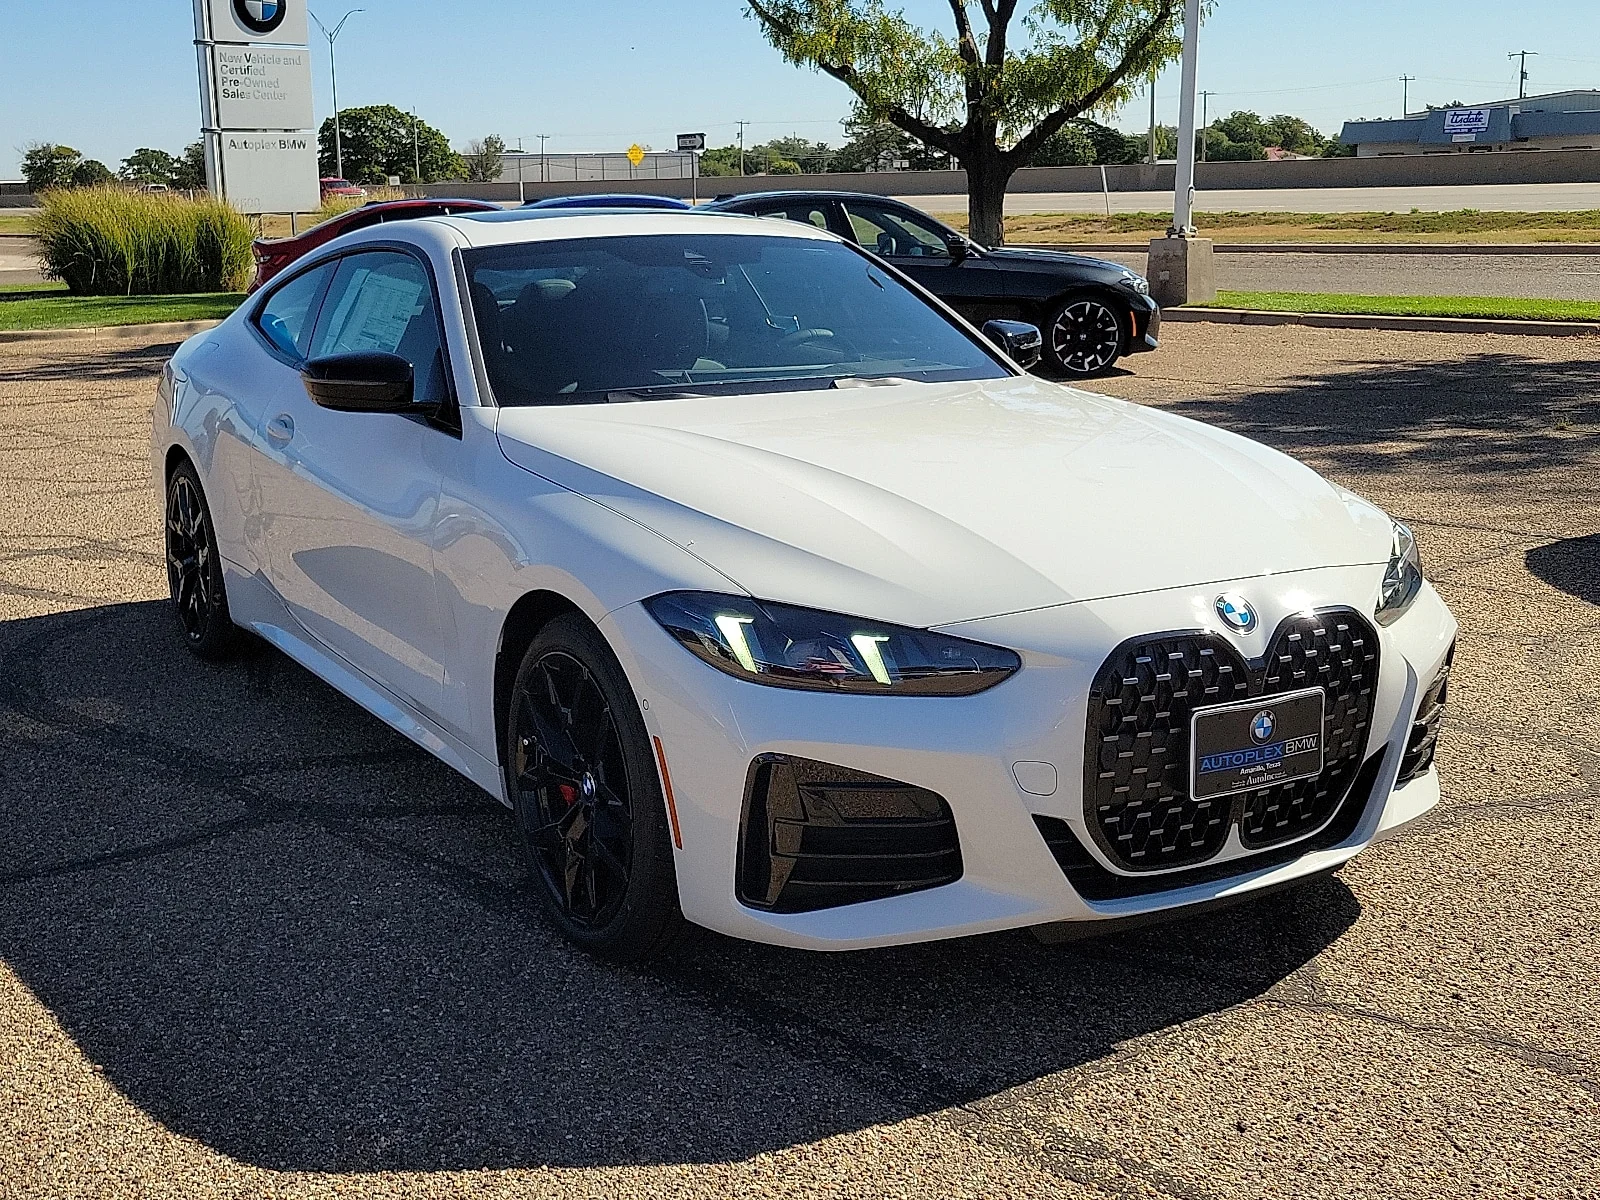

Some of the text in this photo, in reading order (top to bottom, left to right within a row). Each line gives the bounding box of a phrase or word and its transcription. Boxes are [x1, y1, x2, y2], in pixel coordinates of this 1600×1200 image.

[219, 52, 302, 66] New Vehicle and
[220, 64, 266, 76] Certified
[221, 76, 280, 89] Pre-Owned
[222, 88, 287, 100] Sales Center
[228, 139, 307, 152] Autoplex BMW
[1200, 736, 1317, 771] AUTOPLEX BMW
[1266, 761, 1281, 769] Texas
